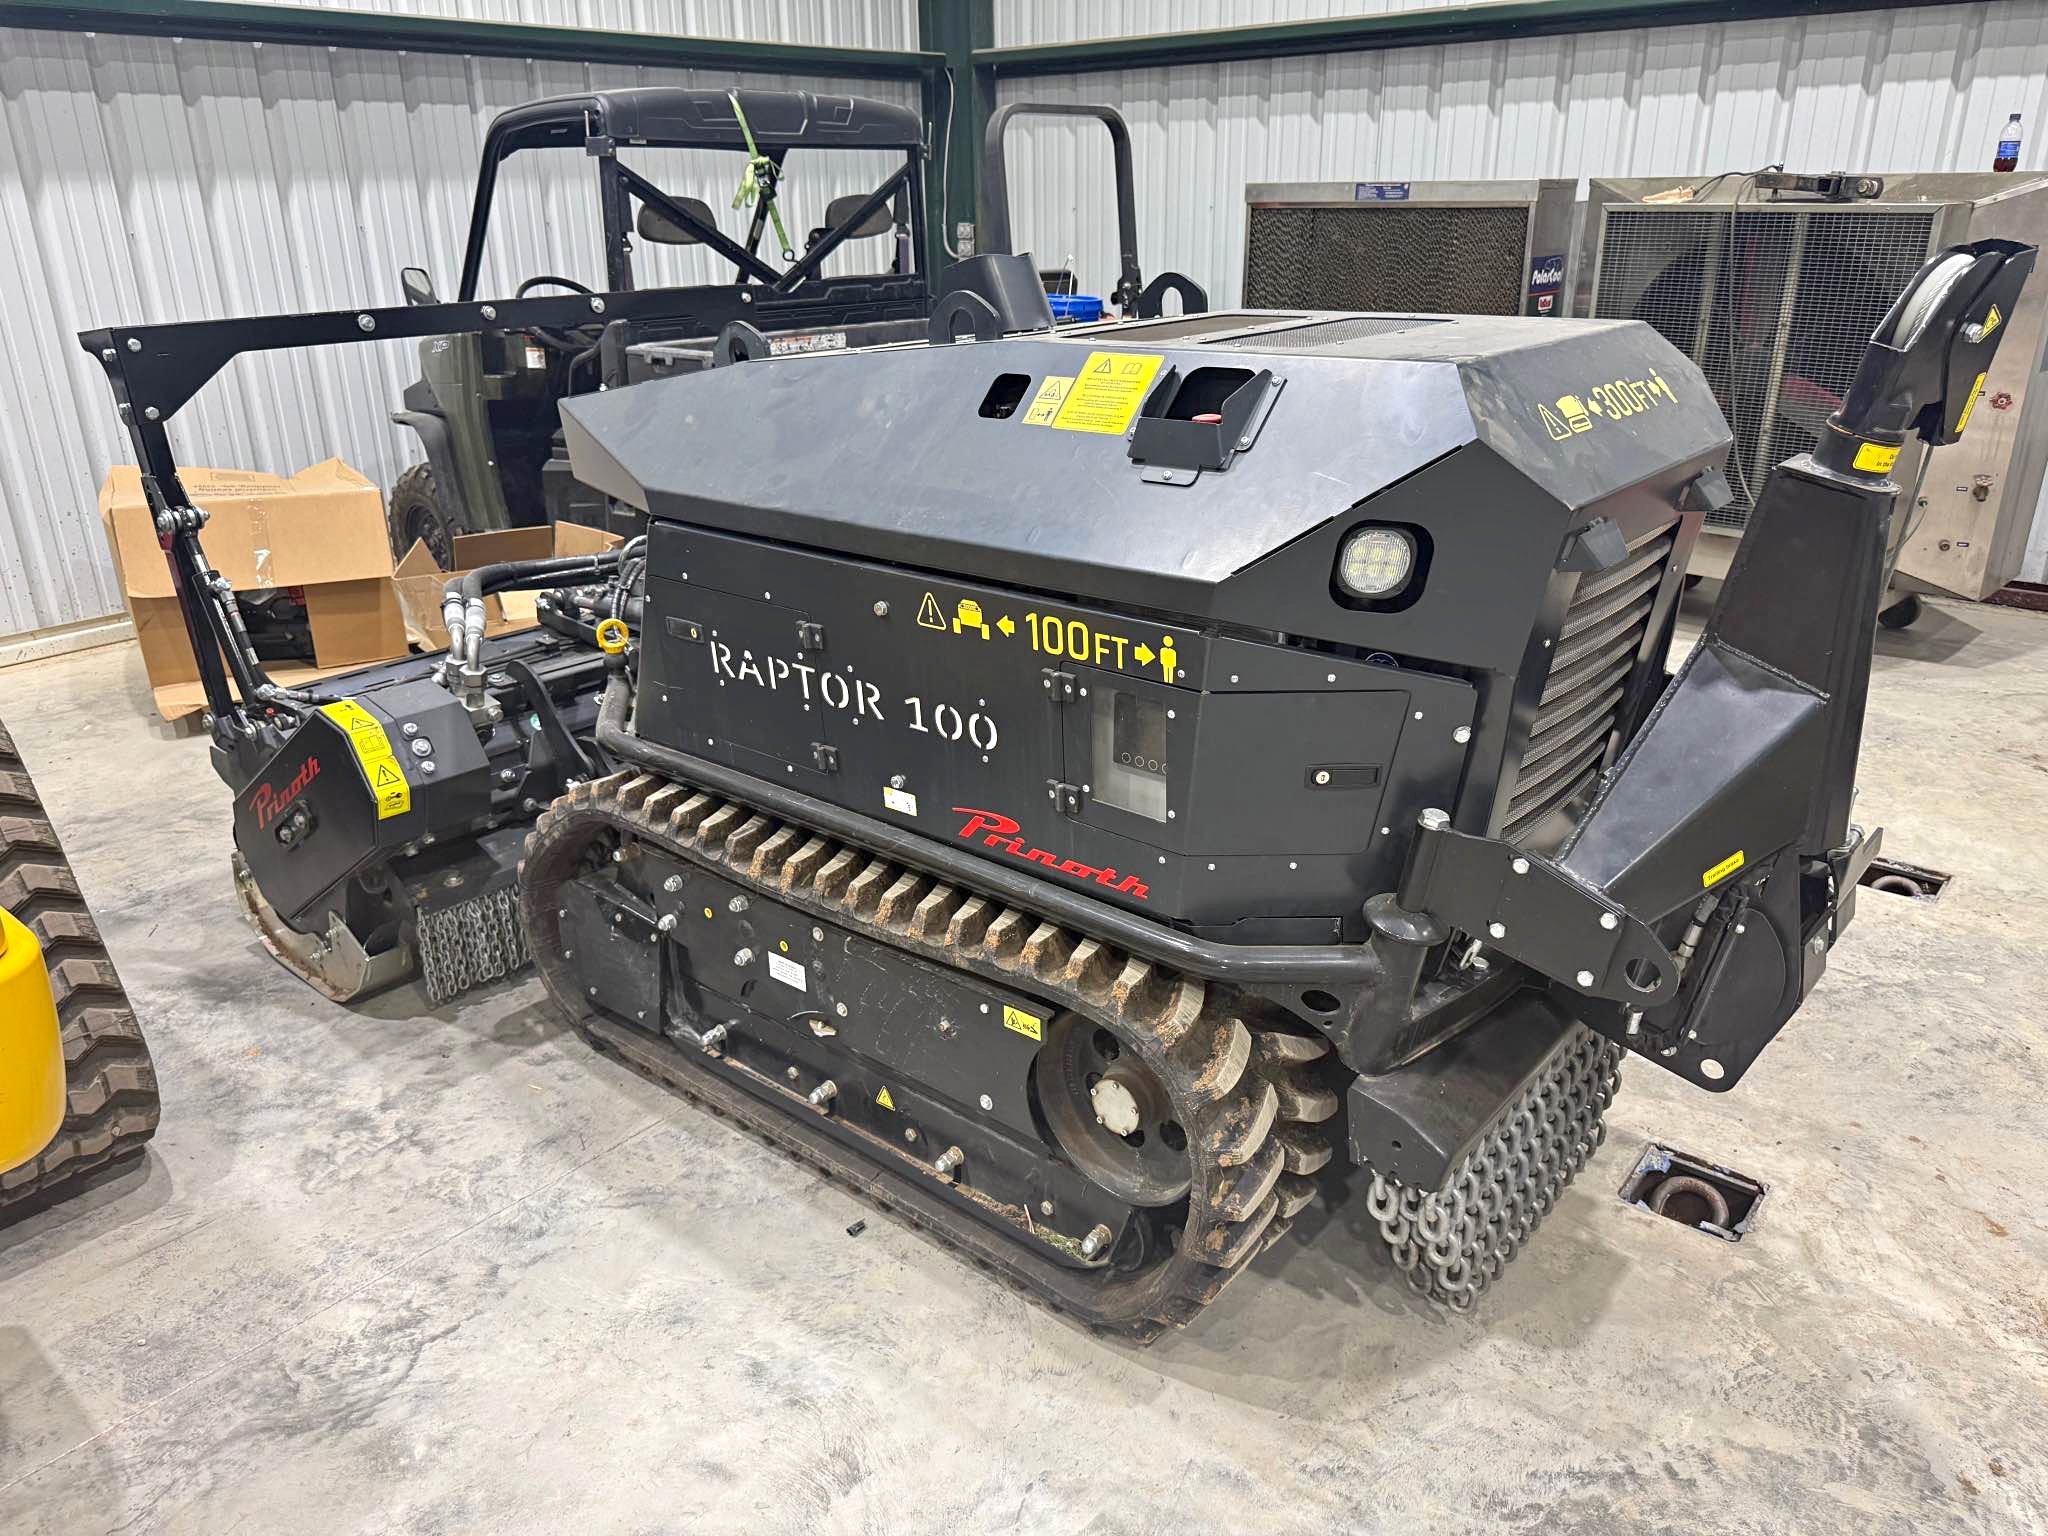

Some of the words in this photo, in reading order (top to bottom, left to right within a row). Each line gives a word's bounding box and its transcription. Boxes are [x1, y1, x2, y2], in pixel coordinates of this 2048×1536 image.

[1592, 380, 1658, 421] 300FT
[1025, 612, 1129, 669] 100FT
[709, 640, 885, 720] RAPTOR
[904, 696, 998, 751] 100
[249, 755, 321, 832] Prinoth
[951, 807, 1149, 900] Prinoth
